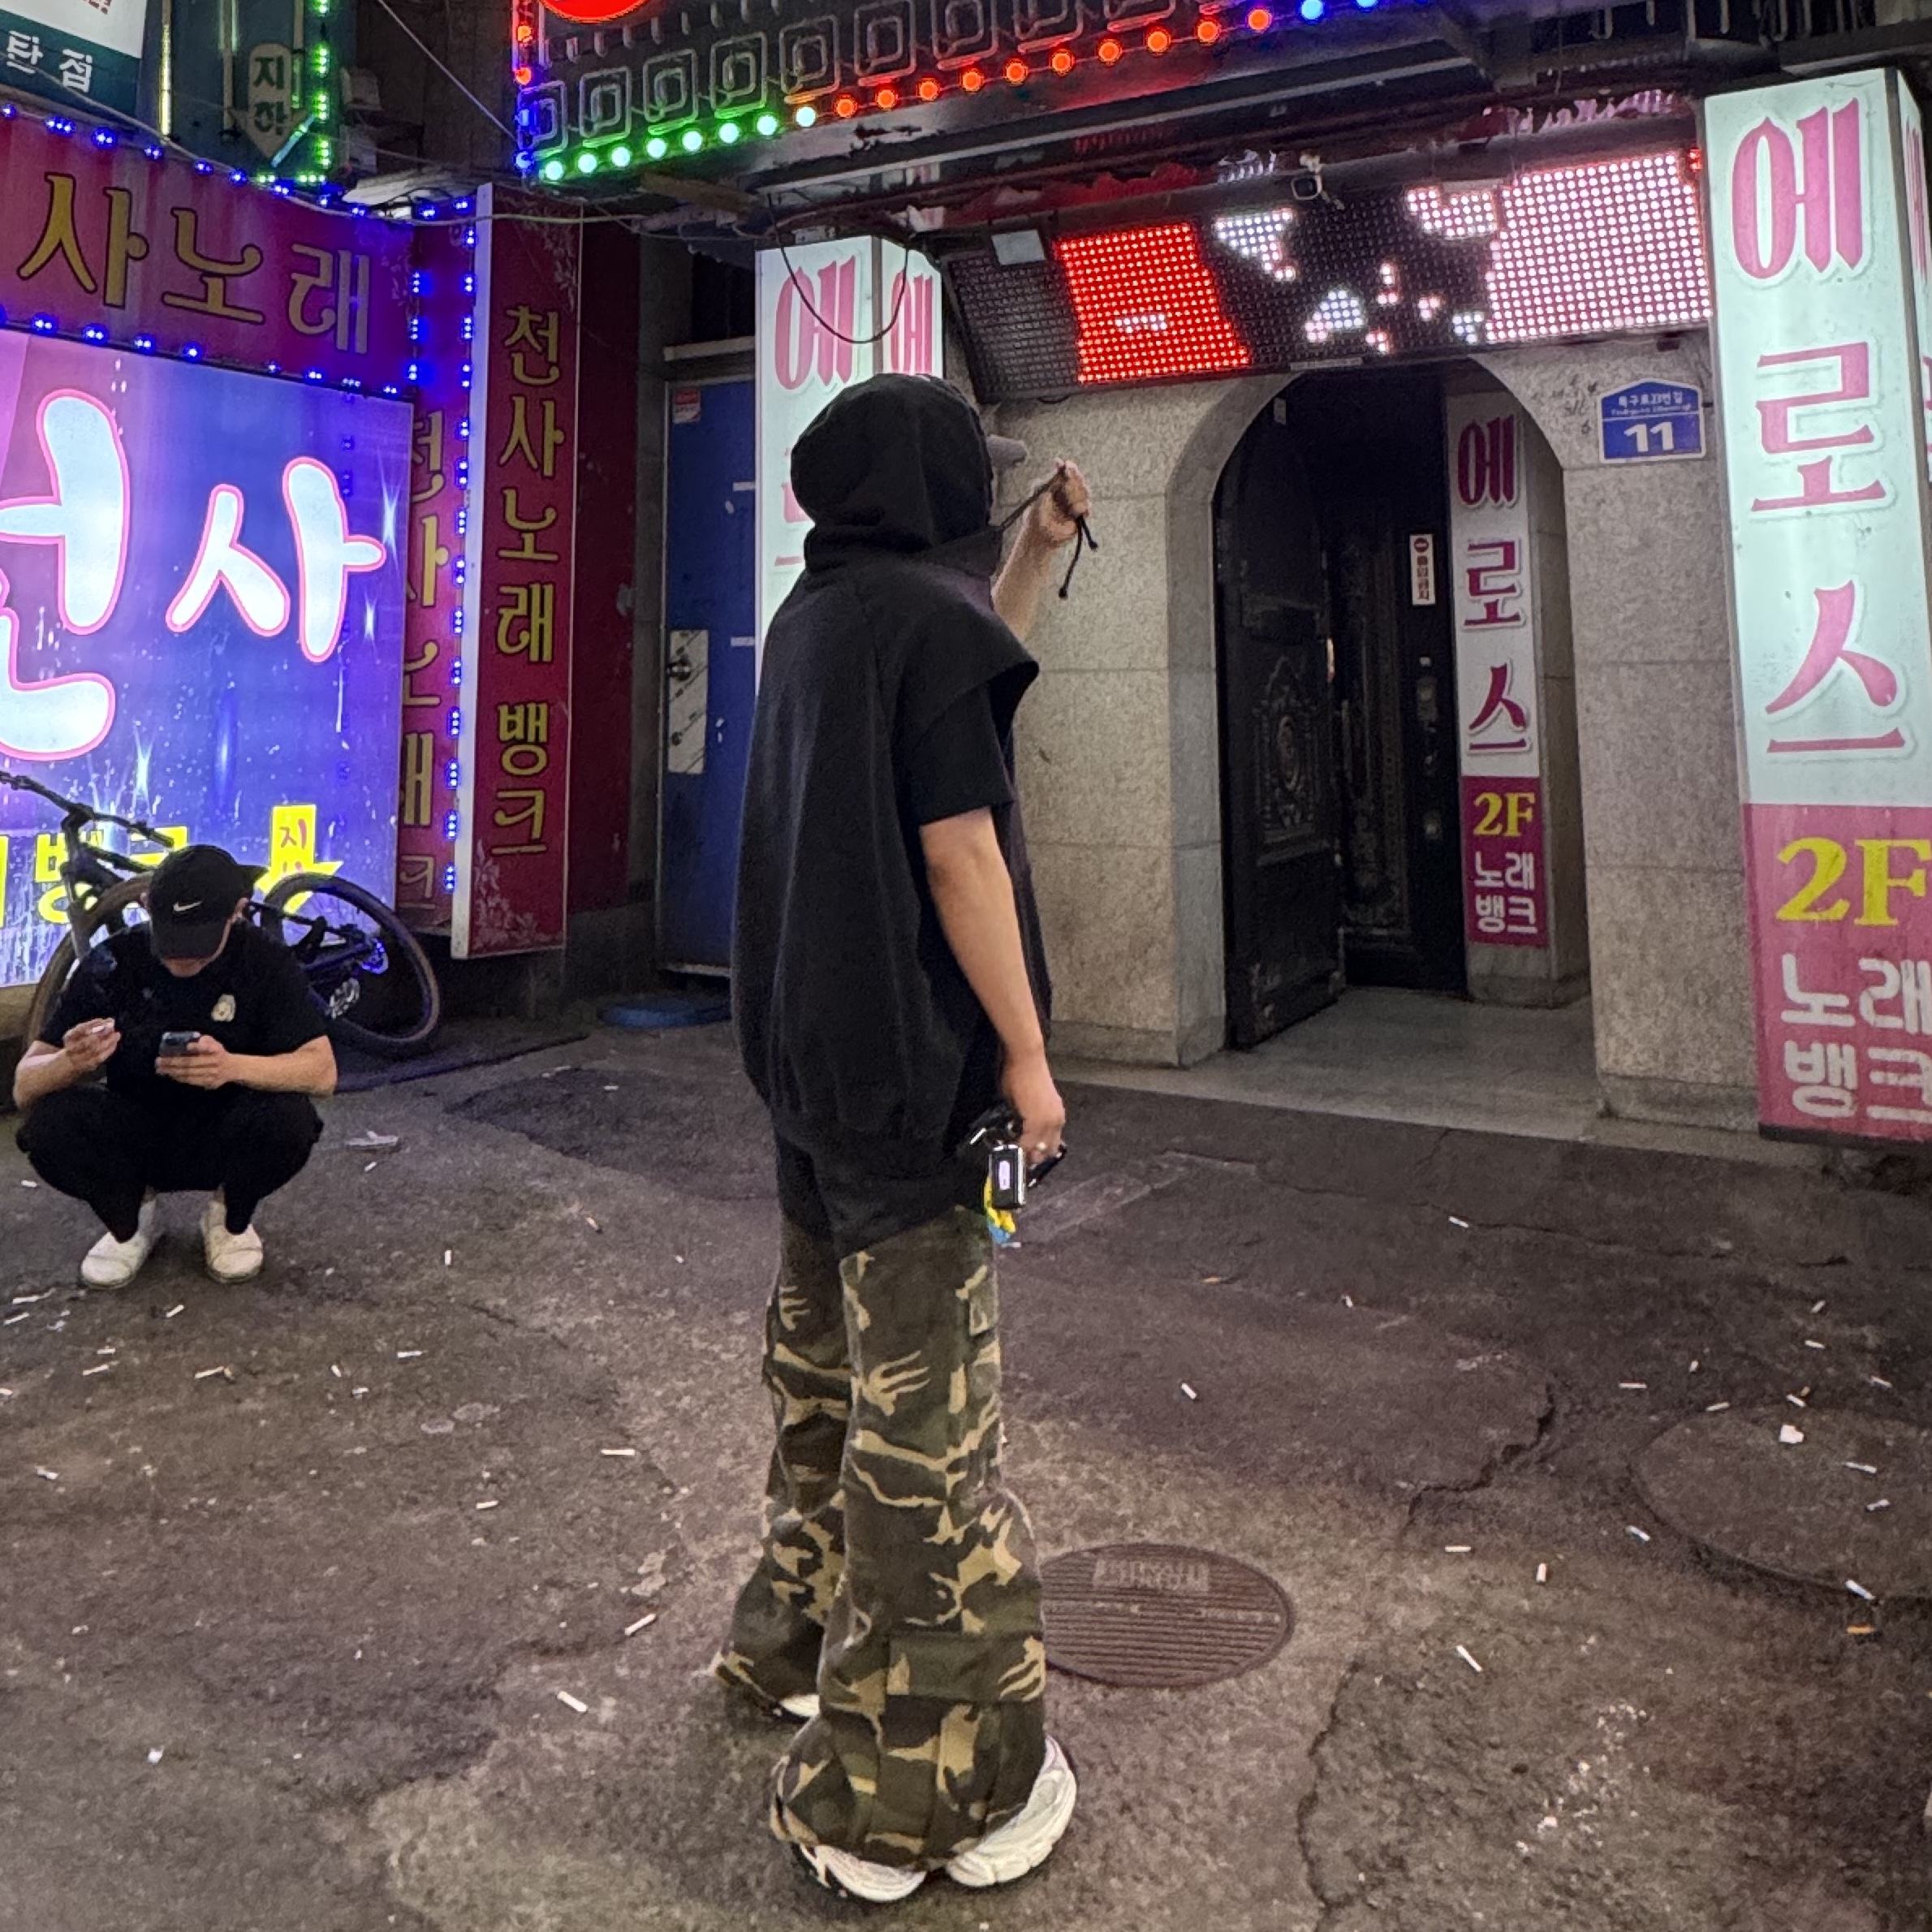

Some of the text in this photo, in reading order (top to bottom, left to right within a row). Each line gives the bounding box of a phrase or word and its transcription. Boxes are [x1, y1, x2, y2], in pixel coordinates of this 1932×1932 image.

[252, 55, 288, 136] 지하
[1624, 421, 1675, 452] 11
[1731, 97, 1905, 753] 에로스
[491, 304, 566, 856] 천사노래 뱅크
[1457, 414, 1529, 753] 에로스
[1473, 792, 1536, 837] 2F
[1474, 851, 1535, 891] 노래
[1776, 837, 1932, 926] 2F
[1475, 894, 1537, 934] 뱅크
[1781, 954, 1932, 1035] 노래
[1783, 1041, 1932, 1122] 뱅크
